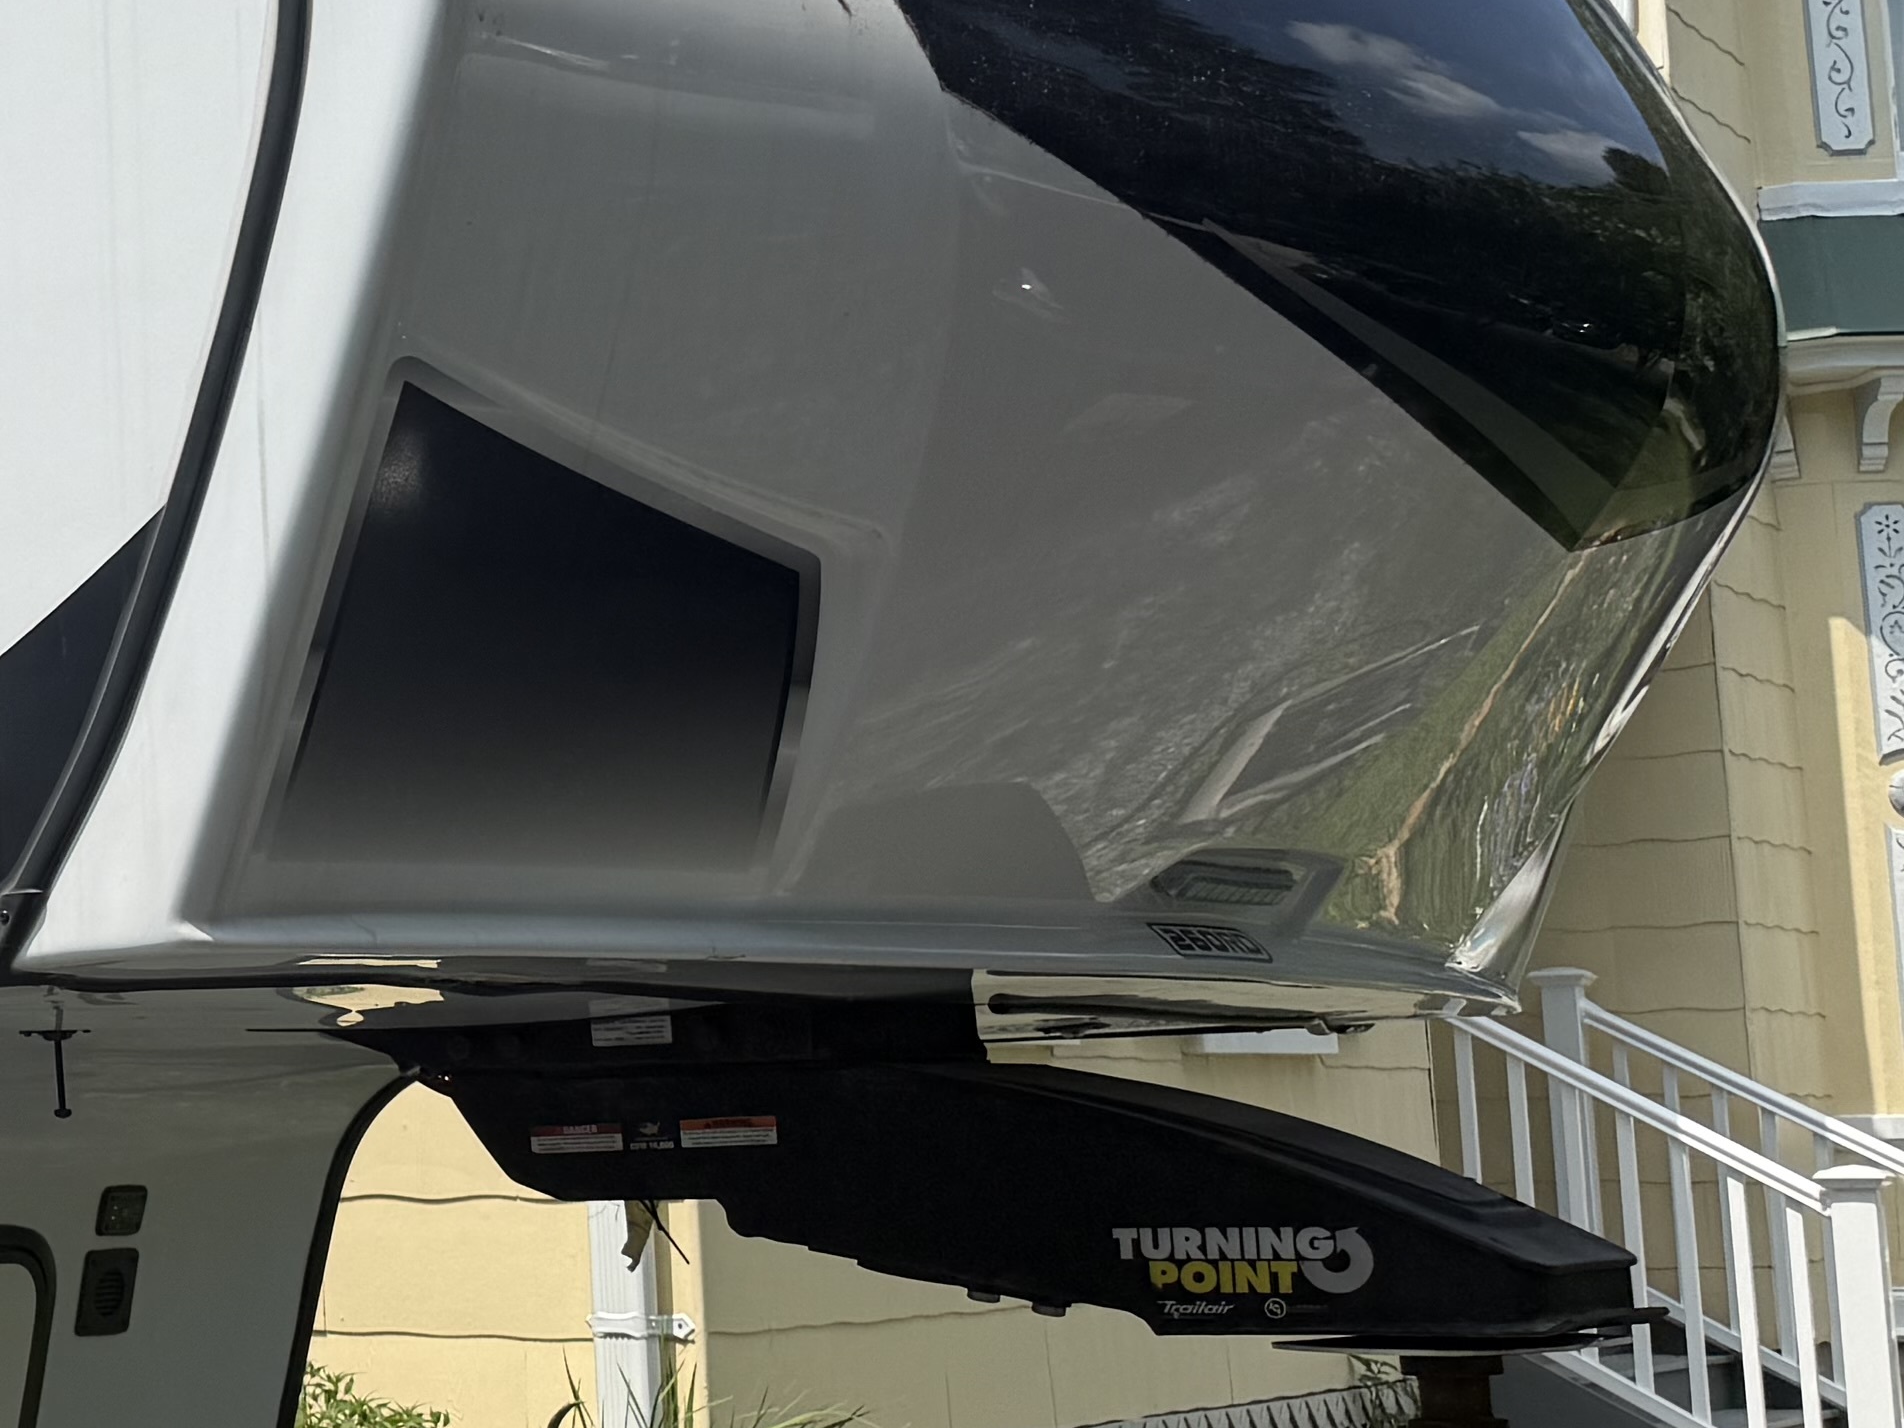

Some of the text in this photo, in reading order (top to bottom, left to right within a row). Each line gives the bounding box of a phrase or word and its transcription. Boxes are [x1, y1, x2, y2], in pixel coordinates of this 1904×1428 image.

[1112, 1226, 1335, 1260] TURNING
[1148, 1260, 1298, 1295] POINT
[1156, 1300, 1236, 1320] Trailair
